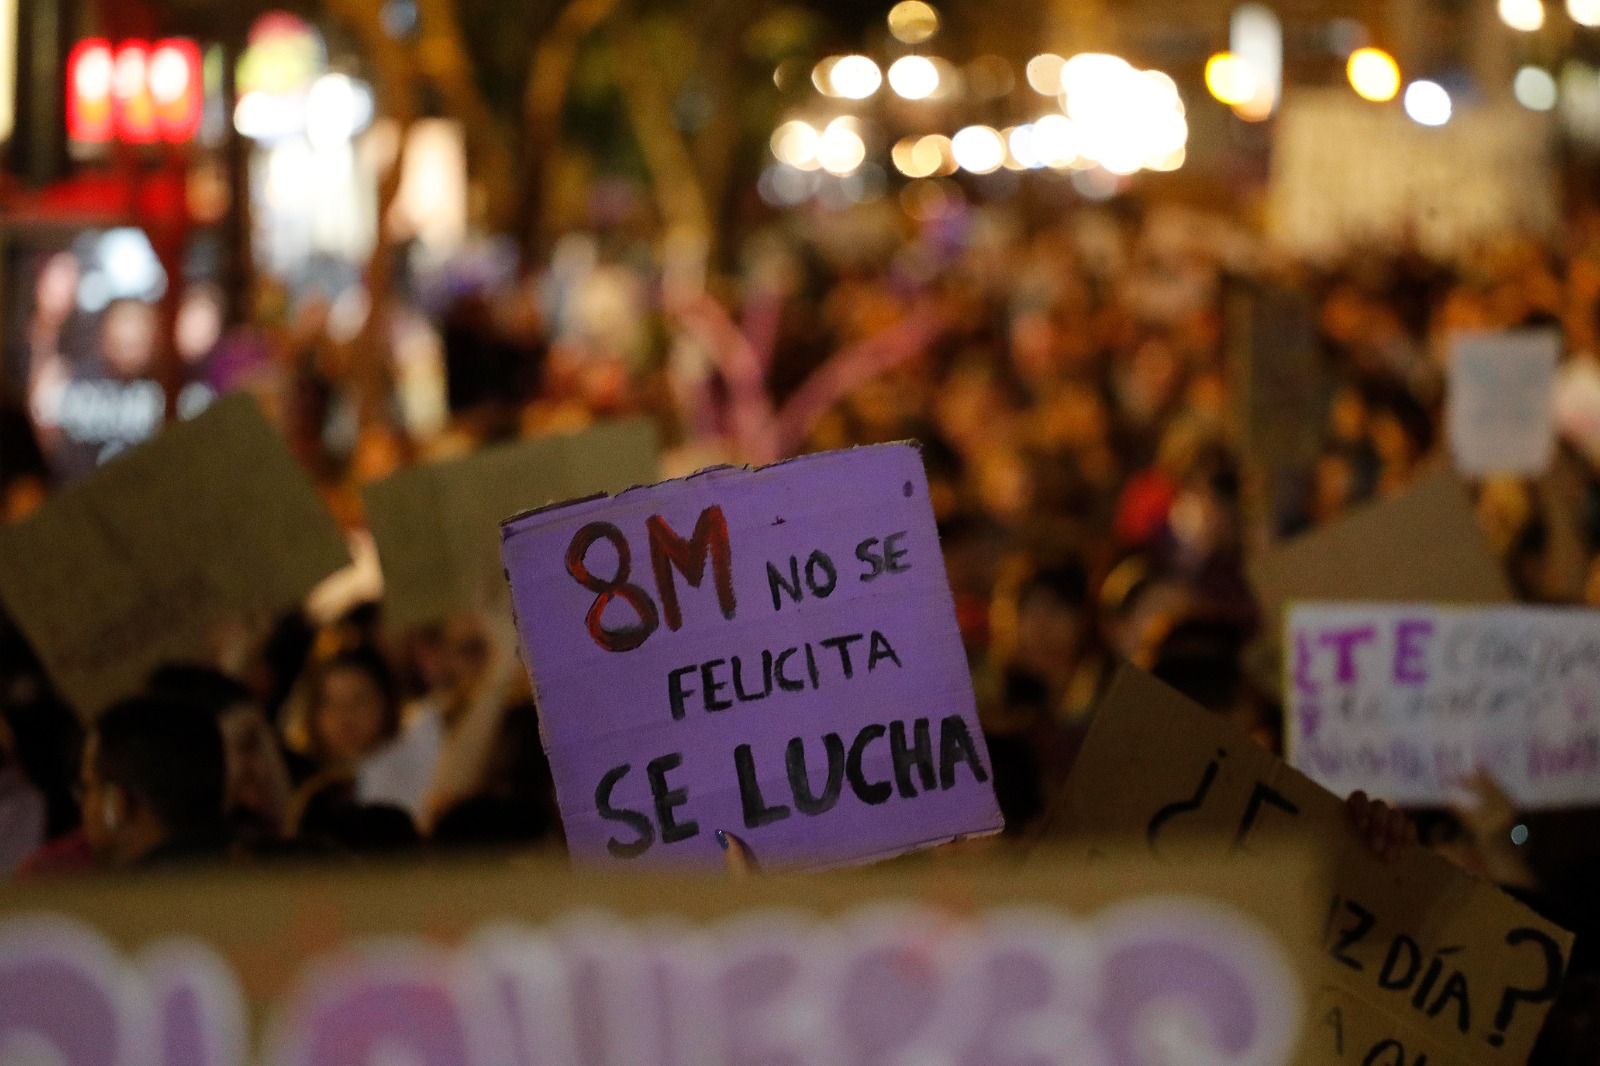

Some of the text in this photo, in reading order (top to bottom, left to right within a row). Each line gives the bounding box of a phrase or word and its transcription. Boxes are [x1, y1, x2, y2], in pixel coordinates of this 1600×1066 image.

[565, 504, 912, 652] 8M NO SE
[668, 630, 902, 720] FELICITA
[594, 714, 989, 859] SE LUCHA
